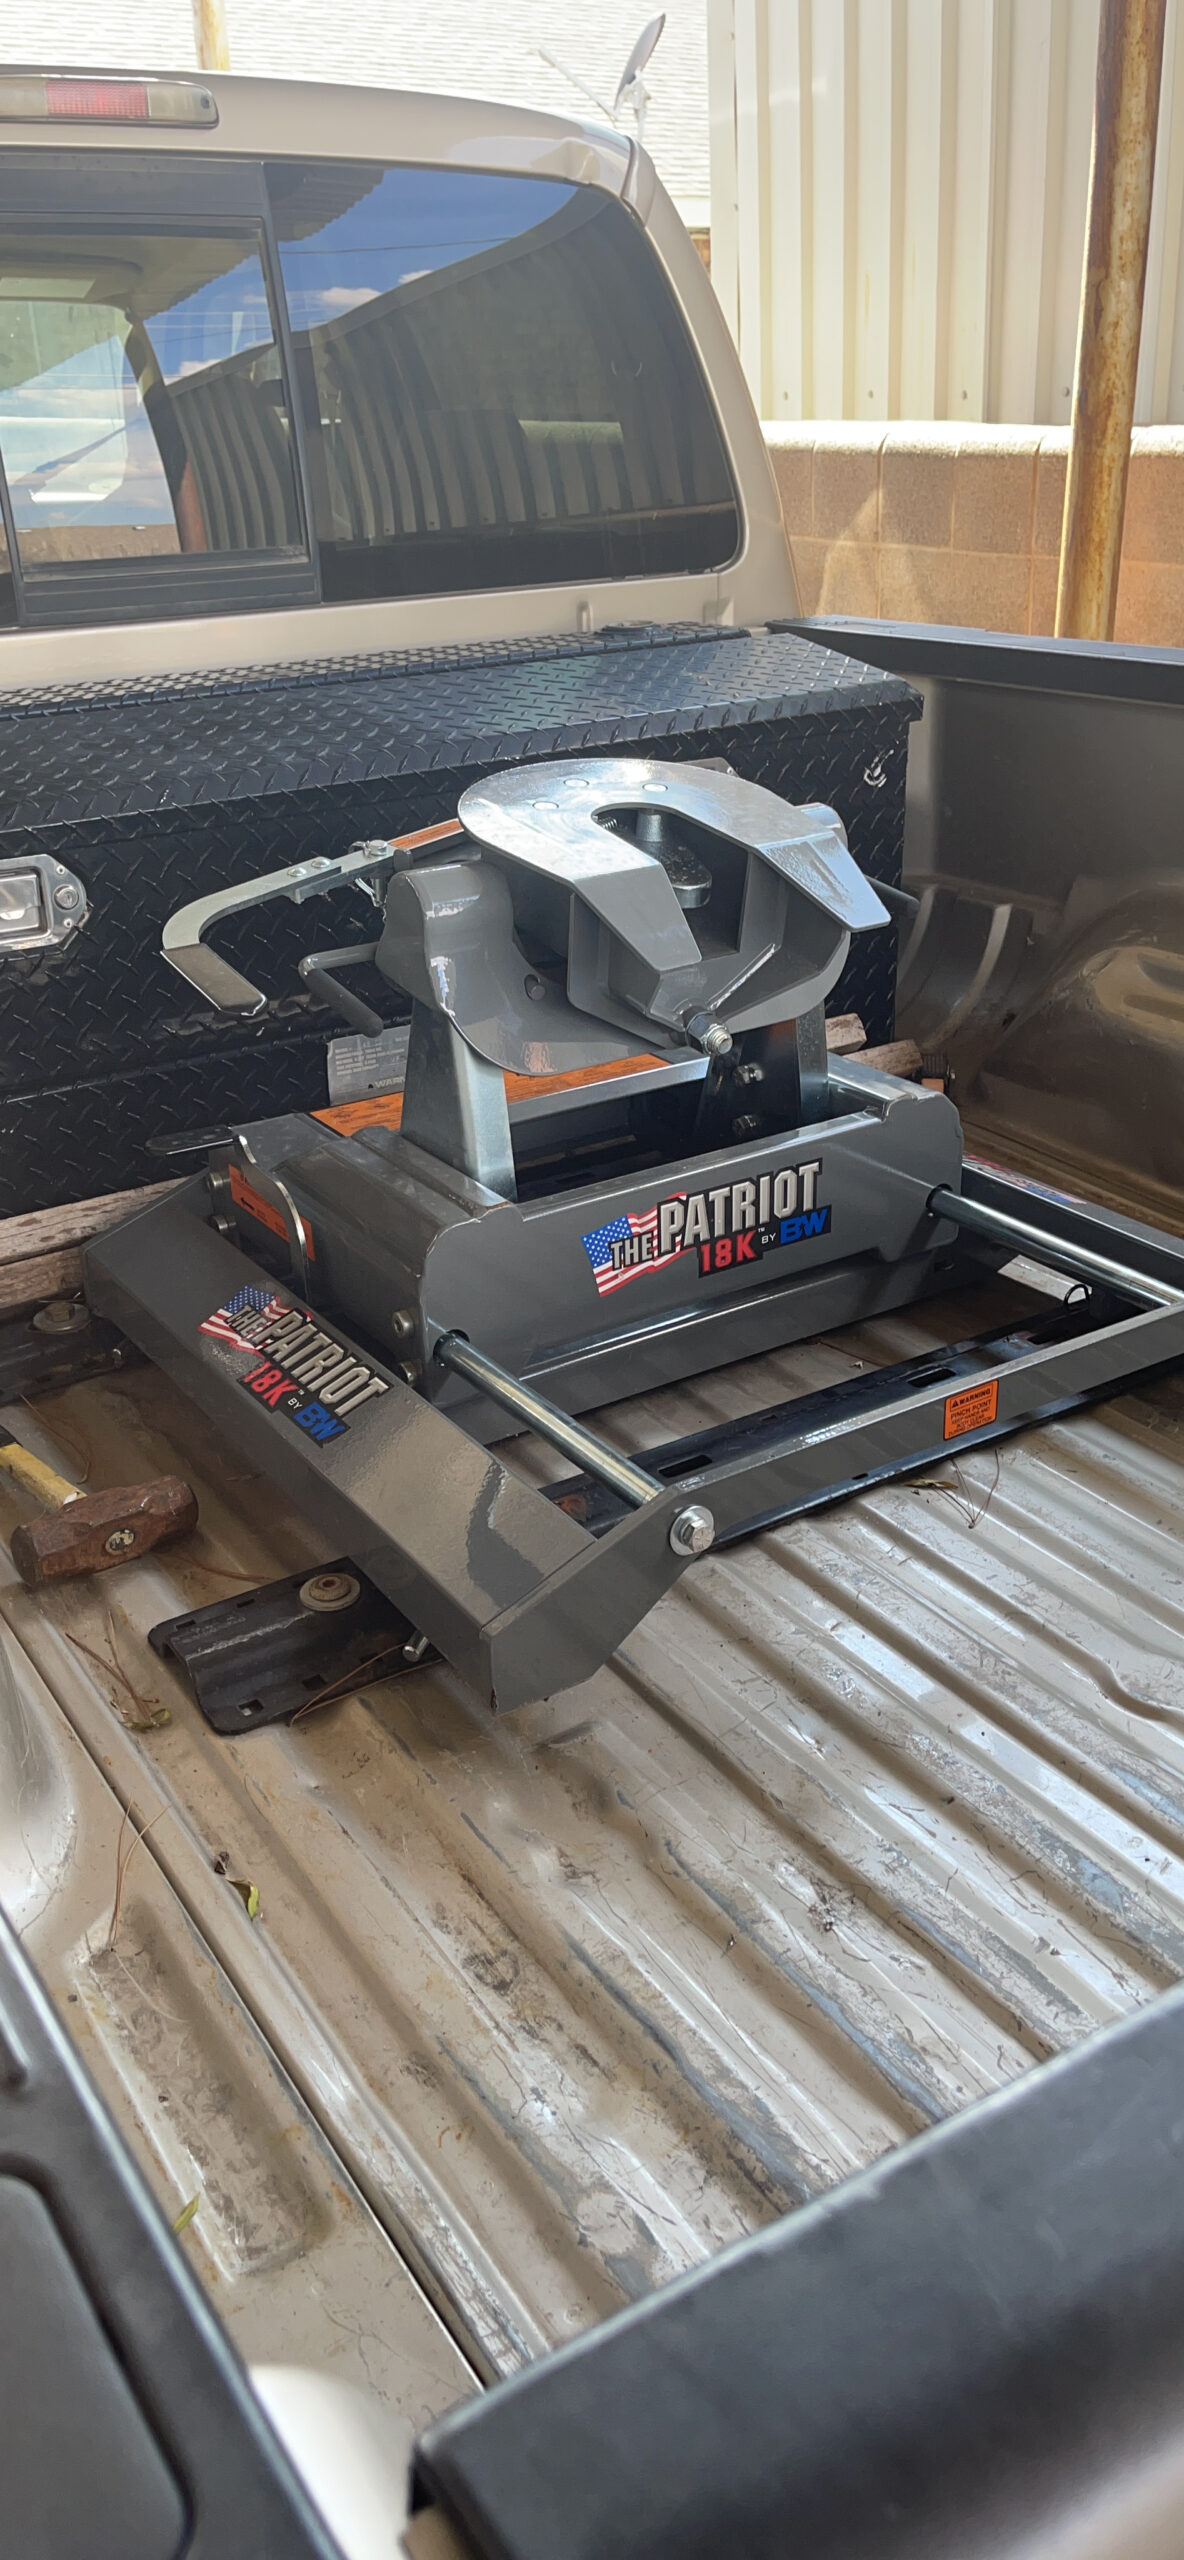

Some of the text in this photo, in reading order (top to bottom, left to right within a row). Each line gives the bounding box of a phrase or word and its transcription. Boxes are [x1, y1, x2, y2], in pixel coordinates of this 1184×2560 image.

[610, 1161, 820, 1268] THE PATRIOT
[700, 1230, 757, 1272] 18K
[761, 1232, 776, 1244] BY
[227, 1305, 389, 1416] THE PATRIOT
[243, 1362, 298, 1407] 18K
[287, 1397, 303, 1410] BY
[959, 1388, 991, 1405] WARNING
[951, 1407, 970, 1420] PINCH
[972, 1399, 992, 1411] POINT
